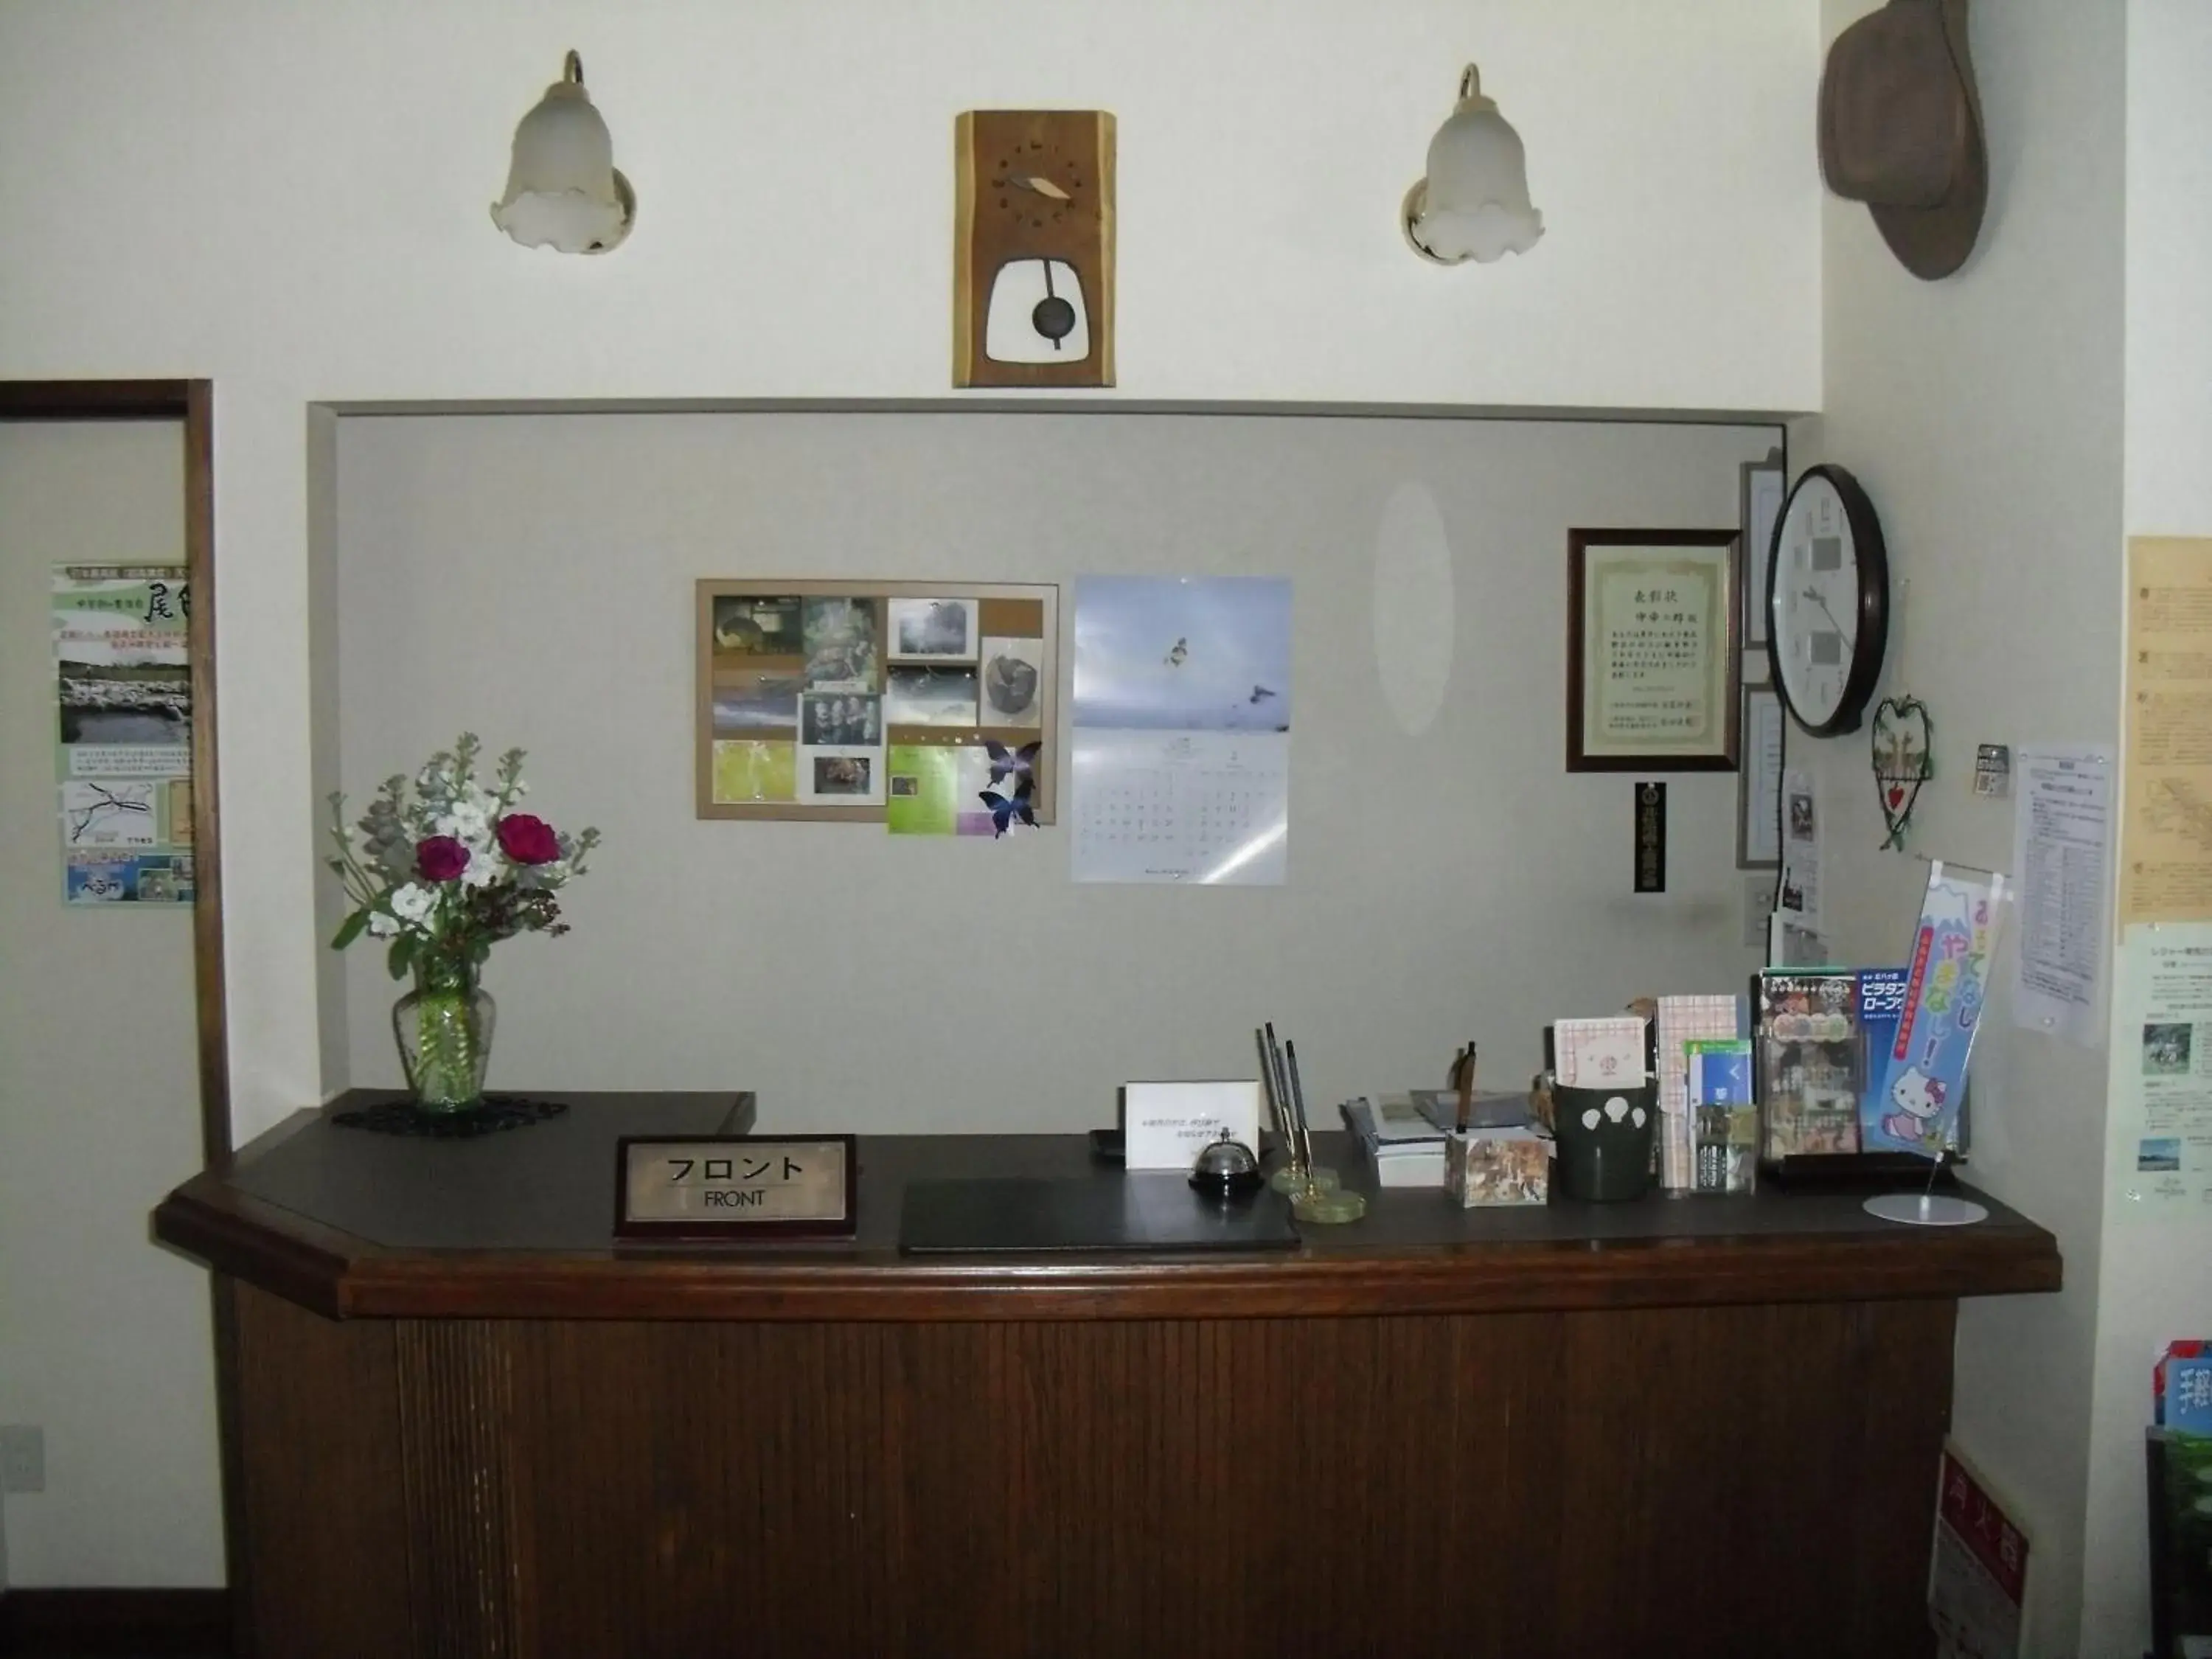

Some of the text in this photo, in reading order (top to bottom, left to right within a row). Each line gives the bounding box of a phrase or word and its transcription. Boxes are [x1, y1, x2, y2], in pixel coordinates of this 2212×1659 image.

[1958, 900, 1989, 1029] おもてなし
[667, 1155, 803, 1180] フロント
[704, 1189, 766, 1208] FRONT
